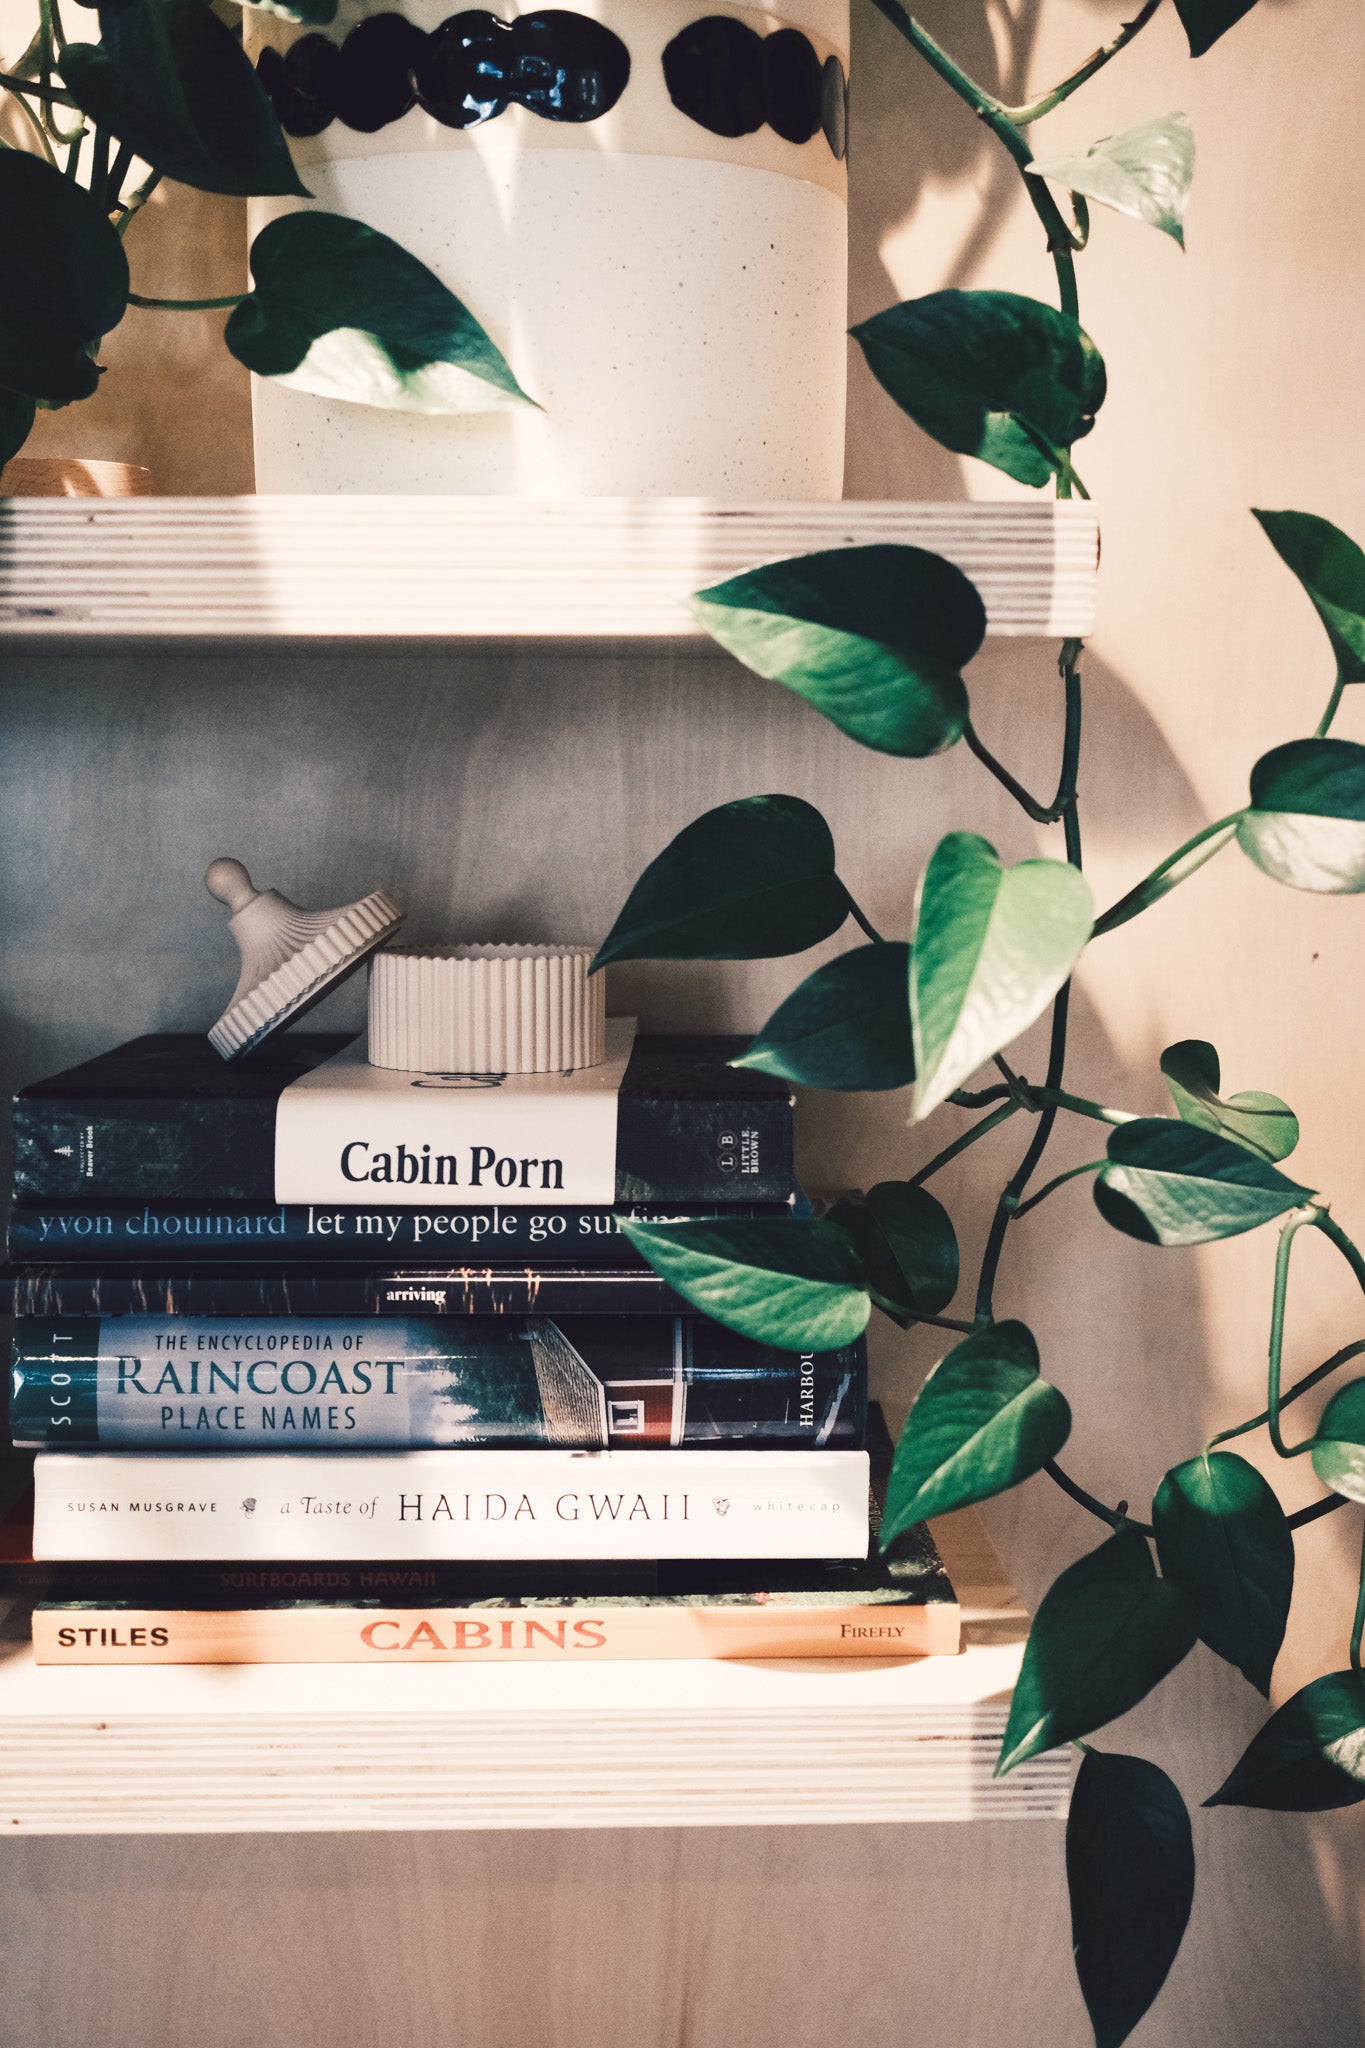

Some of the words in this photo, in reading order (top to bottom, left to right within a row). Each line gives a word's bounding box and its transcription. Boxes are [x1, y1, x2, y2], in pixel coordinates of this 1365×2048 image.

[86, 1125, 94, 1149] Brook
[721, 1135, 734, 1145] B
[86, 1151, 94, 1177] Beaver
[341, 1142, 458, 1185] Cabin
[469, 1147, 564, 1189] Porn
[721, 1157, 734, 1166] L
[750, 1131, 759, 1174] BROWN
[39, 1216, 114, 1241] yvon
[126, 1207, 287, 1234] chouinard
[307, 1207, 345, 1234] let
[355, 1216, 403, 1241] my
[414, 1207, 517, 1242] people
[530, 1216, 567, 1242] go
[387, 1286, 447, 1305] arriving
[155, 1335, 188, 1351] THE
[198, 1335, 333, 1351] ENCYCLOPEDIA
[343, 1335, 364, 1351] OF
[49, 1333, 73, 1426] SCOTT
[116, 1355, 405, 1395] RAINCOAST
[800, 1352, 814, 1427] HARBOU
[161, 1406, 246, 1430] PLACE
[262, 1406, 356, 1430] NAMES
[67, 1502, 120, 1512] SUSAN
[129, 1502, 217, 1513] MUSGRAVE
[281, 1502, 291, 1515] a
[301, 1496, 352, 1515] Taste
[359, 1496, 380, 1520] of
[399, 1494, 537, 1521] HAIDA
[556, 1493, 690, 1521] GWAII
[753, 1499, 841, 1515] whitecap
[220, 1572, 351, 1588] SURFBOARDS
[359, 1572, 436, 1587] HAWAII
[58, 1627, 169, 1647] STILES
[360, 1620, 607, 1651] CABINS
